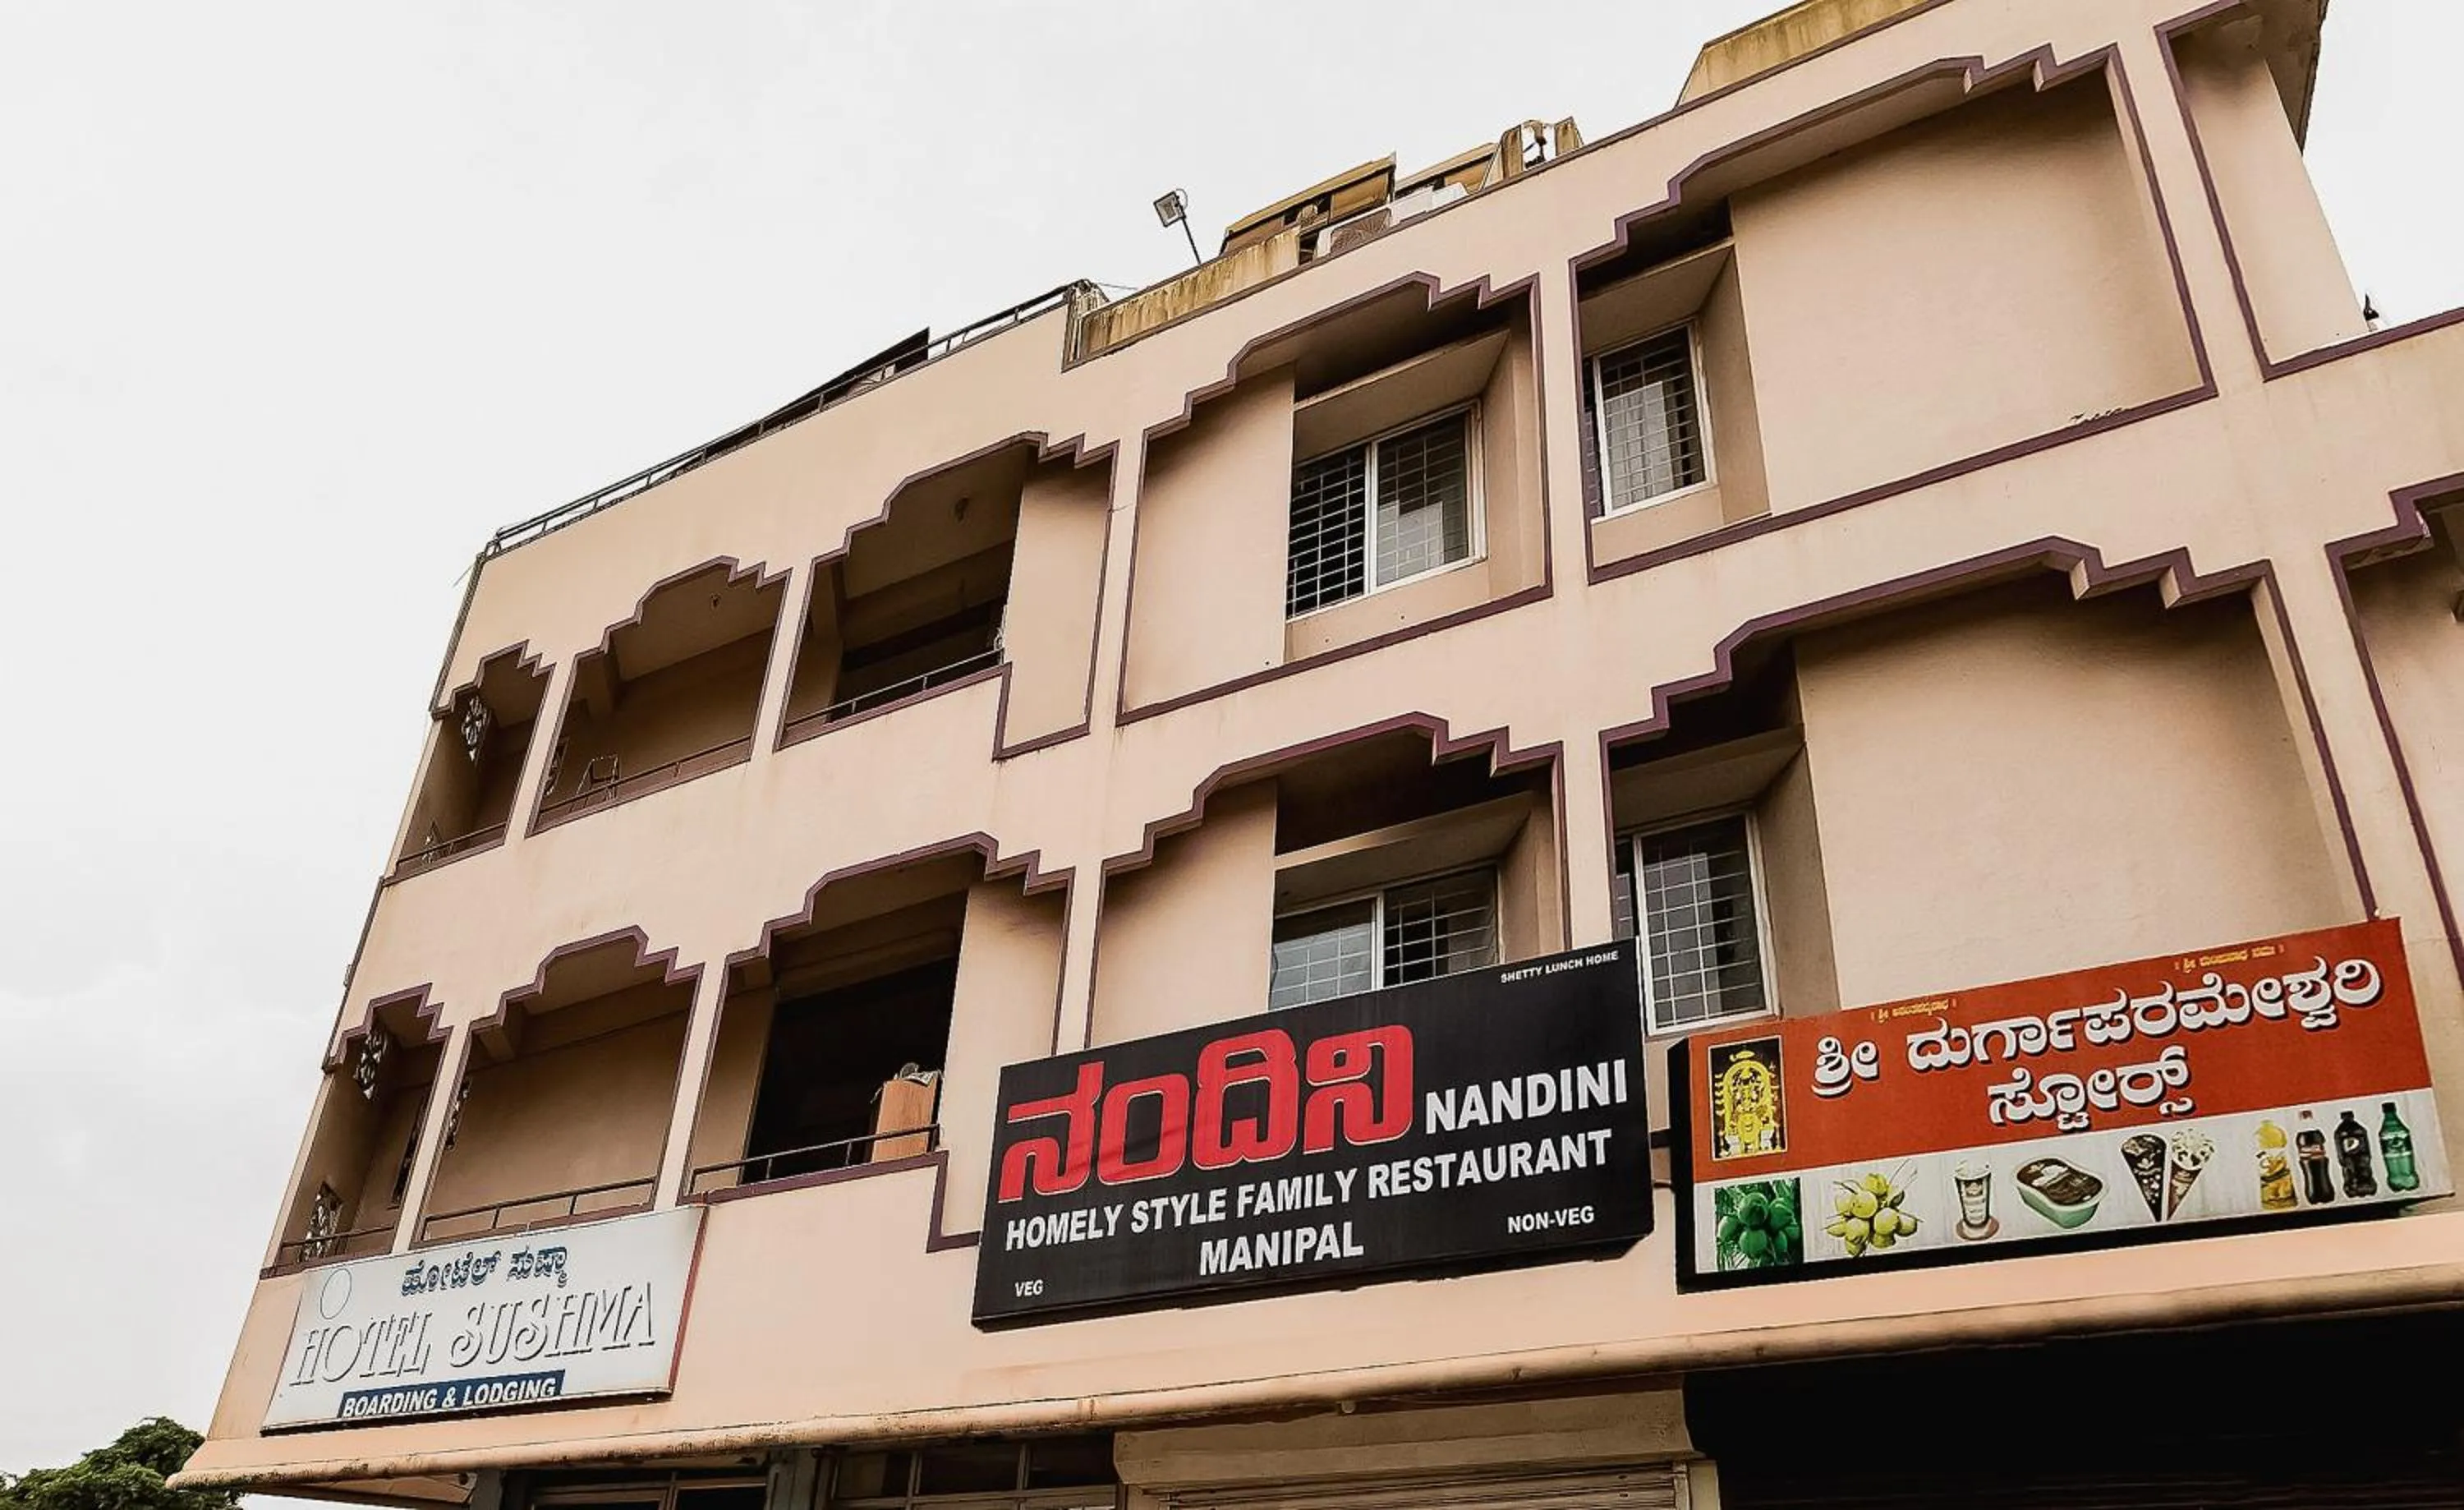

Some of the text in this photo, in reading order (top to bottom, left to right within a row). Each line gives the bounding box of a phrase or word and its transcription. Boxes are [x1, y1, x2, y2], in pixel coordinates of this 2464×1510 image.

[1501, 951, 1619, 983] SHETTY LUNCH HOME
[1810, 955, 2383, 1096] ಶ್ರೀ ದುರ್ಗಾಪರಮೇಶ್ವರಿ
[998, 1024, 1414, 1202] ನಂದಿನಿ
[1425, 1059, 1627, 1135] NANDINI
[1005, 1128, 1612, 1250] HOMELY STYLE FAMILY RESTAURANT
[1507, 1205, 1594, 1232] NON-VEG
[1199, 1222, 1364, 1275] MANIPAL
[1014, 1279, 1044, 1297] VEG
[290, 1282, 655, 1386] HOTEL SUSHMA
[342, 1378, 556, 1417] BOARDING & LODGING
